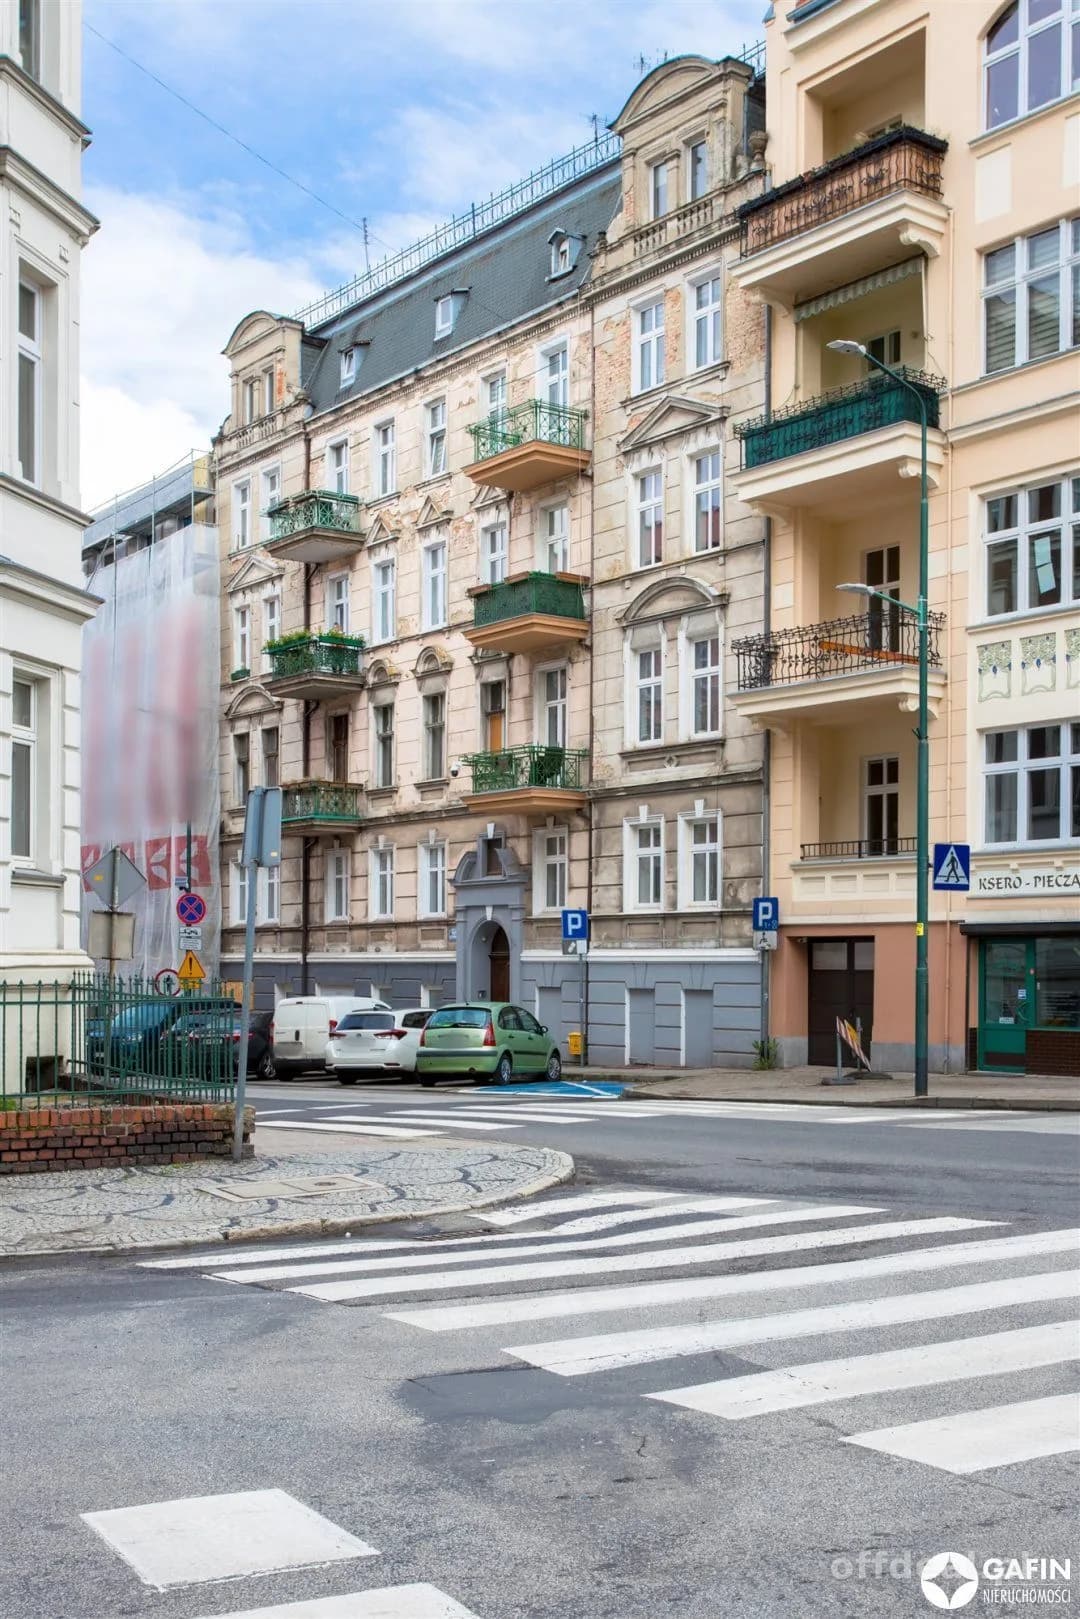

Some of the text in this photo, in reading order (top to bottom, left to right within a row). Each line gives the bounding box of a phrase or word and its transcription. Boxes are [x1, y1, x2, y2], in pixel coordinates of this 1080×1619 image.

[978, 876, 1023, 890] KSERO
[567, 913, 582, 936] P
[758, 902, 773, 927] P
